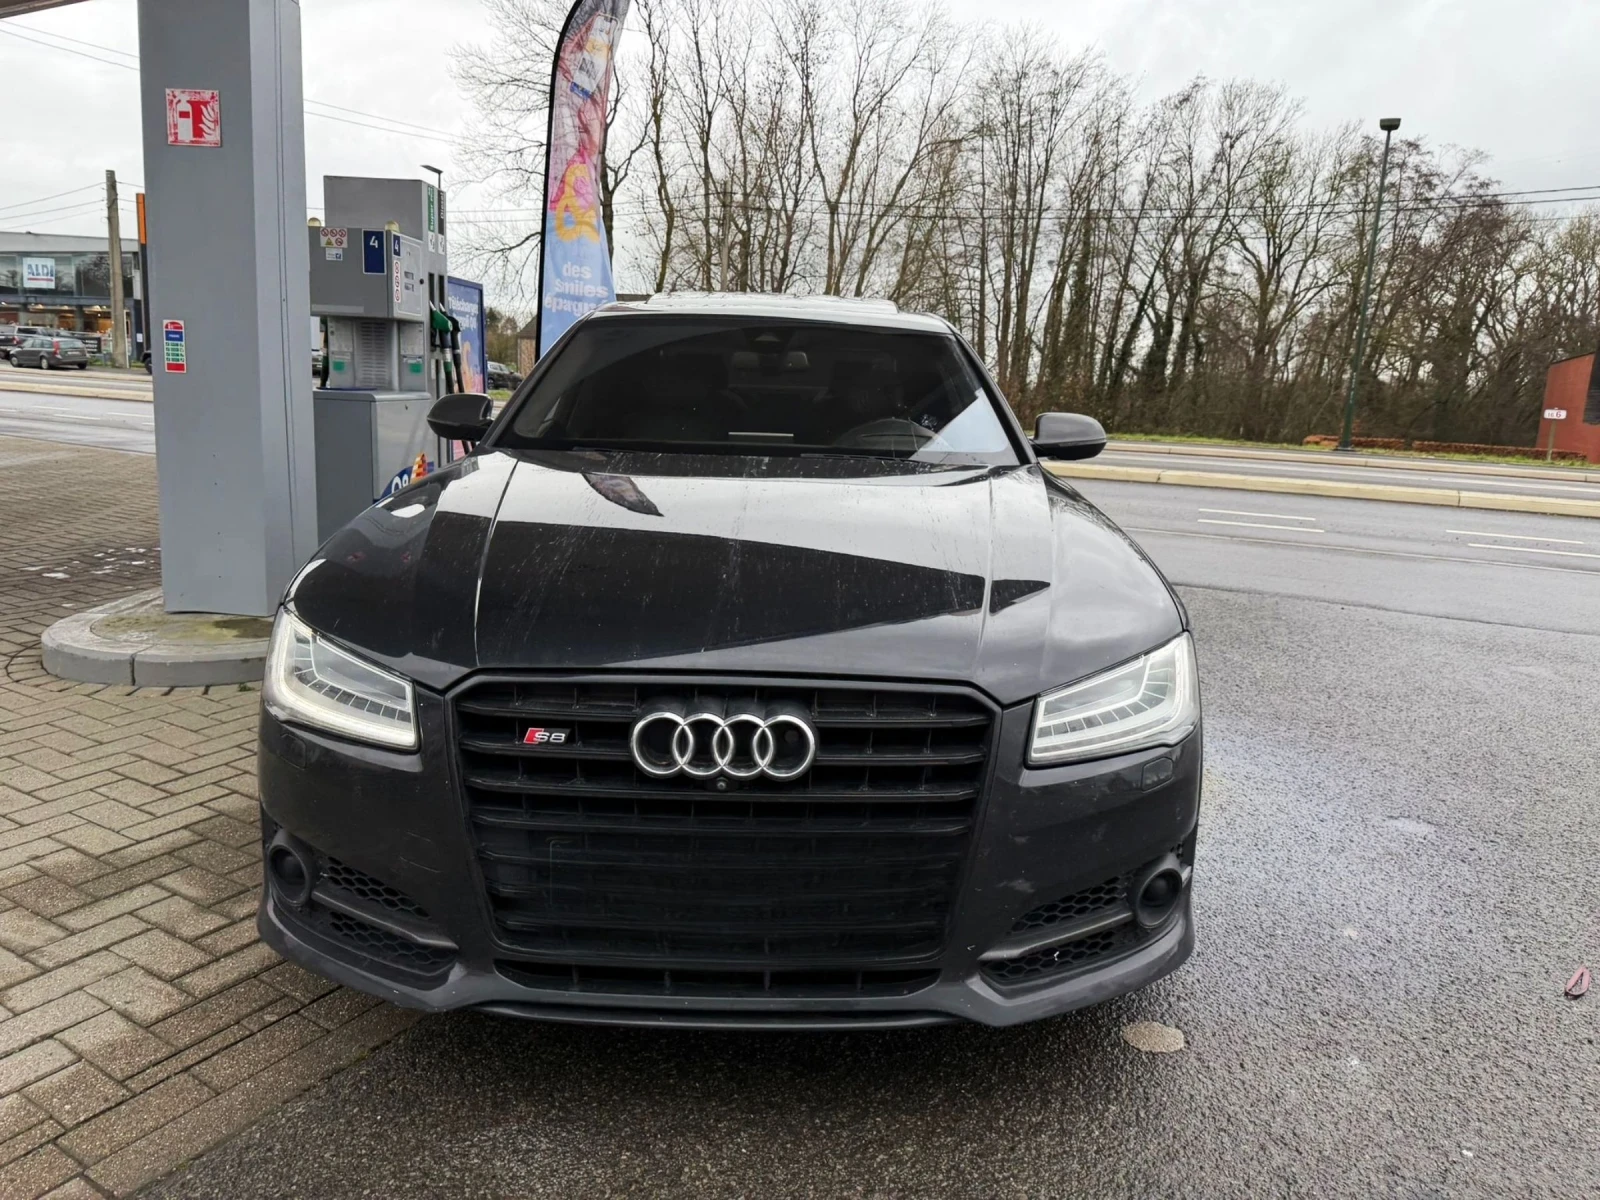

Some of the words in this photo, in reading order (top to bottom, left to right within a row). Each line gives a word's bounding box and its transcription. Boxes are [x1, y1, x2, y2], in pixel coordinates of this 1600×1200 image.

[369, 235, 378, 249] 4
[394, 240, 399, 252] 4
[27, 264, 54, 278] ALDI
[562, 261, 593, 279] des
[555, 278, 609, 299] smiles
[534, 732, 565, 743] S8
